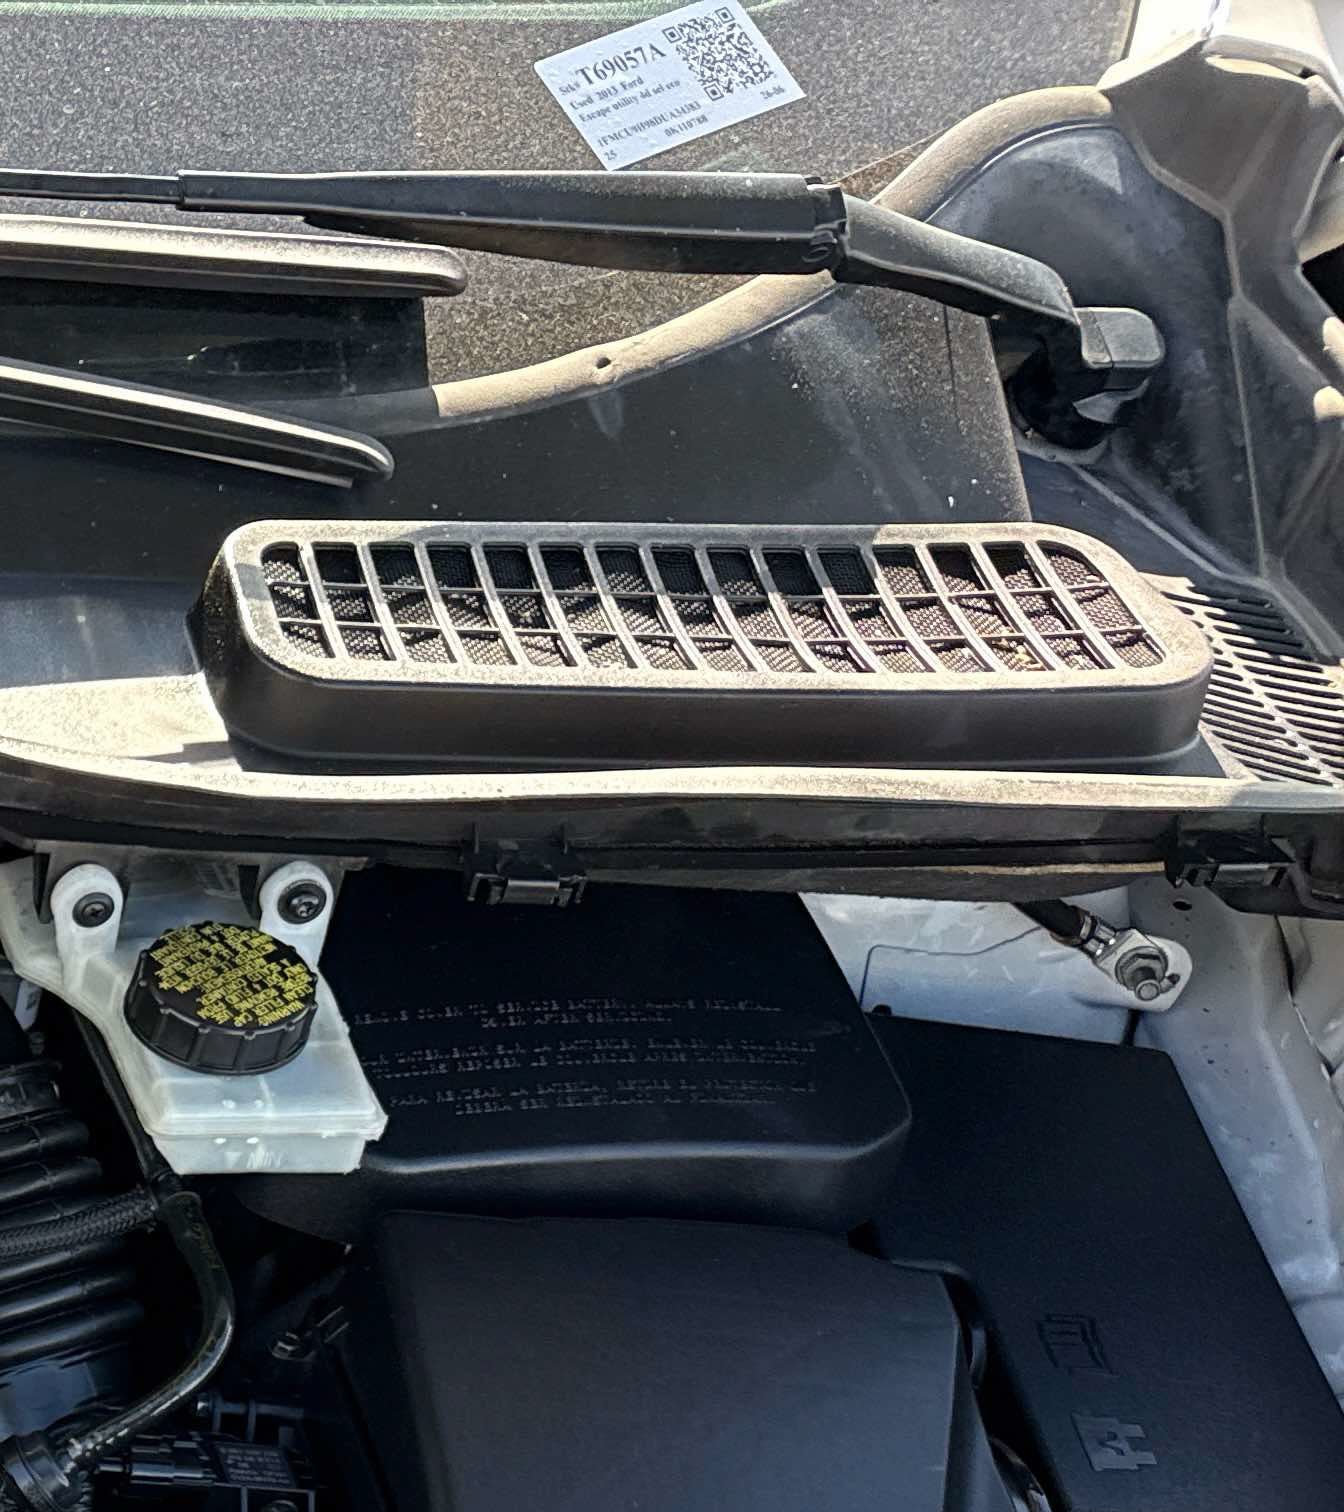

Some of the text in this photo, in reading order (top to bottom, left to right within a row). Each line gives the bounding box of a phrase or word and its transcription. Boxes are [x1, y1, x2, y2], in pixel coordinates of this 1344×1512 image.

[576, 43, 666, 85] T69057A
[570, 77, 644, 109] Used 2013 Ford
[579, 106, 612, 122] Escape
[611, 94, 640, 110] utility
